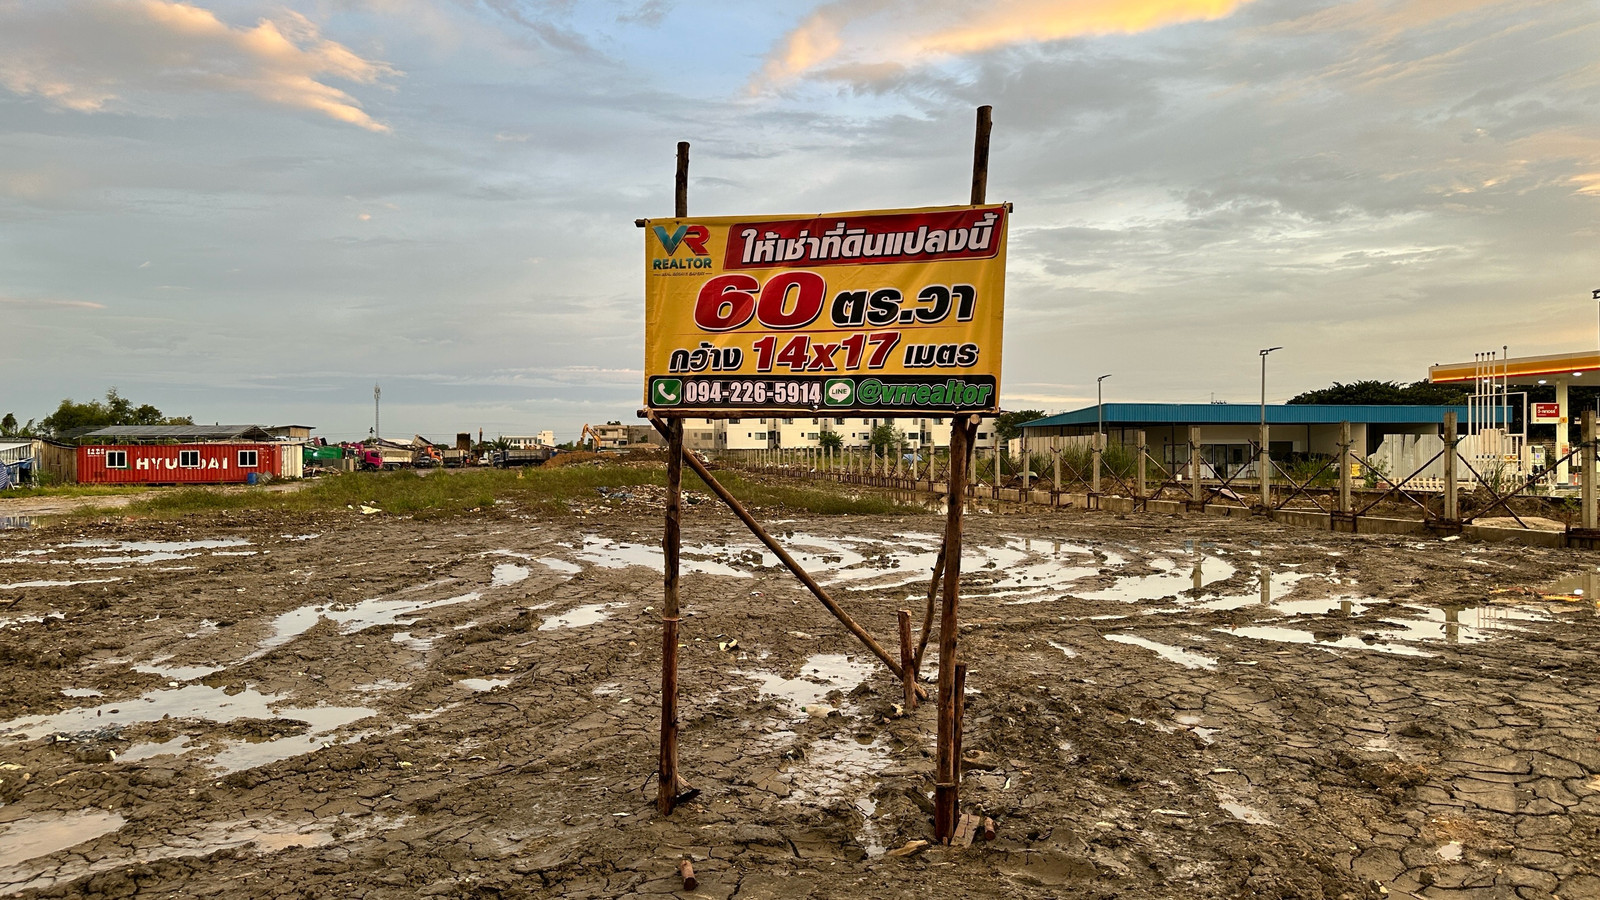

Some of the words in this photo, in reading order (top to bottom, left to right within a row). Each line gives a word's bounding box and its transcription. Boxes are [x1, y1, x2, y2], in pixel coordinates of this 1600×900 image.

[652, 224, 711, 257] VR
[740, 211, 998, 265] ให้เช่าที่ดินแปลงนี้
[653, 257, 713, 270] REALTOR
[694, 271, 827, 332] 60
[831, 284, 978, 327] ตร.วา
[669, 342, 744, 373] กว้าง
[753, 331, 902, 373] 14x17
[903, 342, 980, 369] เมตร
[685, 381, 822, 404] 094-226-5914
[831, 388, 848, 396] LINE
[858, 379, 992, 405] @vrrealtor
[136, 457, 228, 470] HYUDAI
